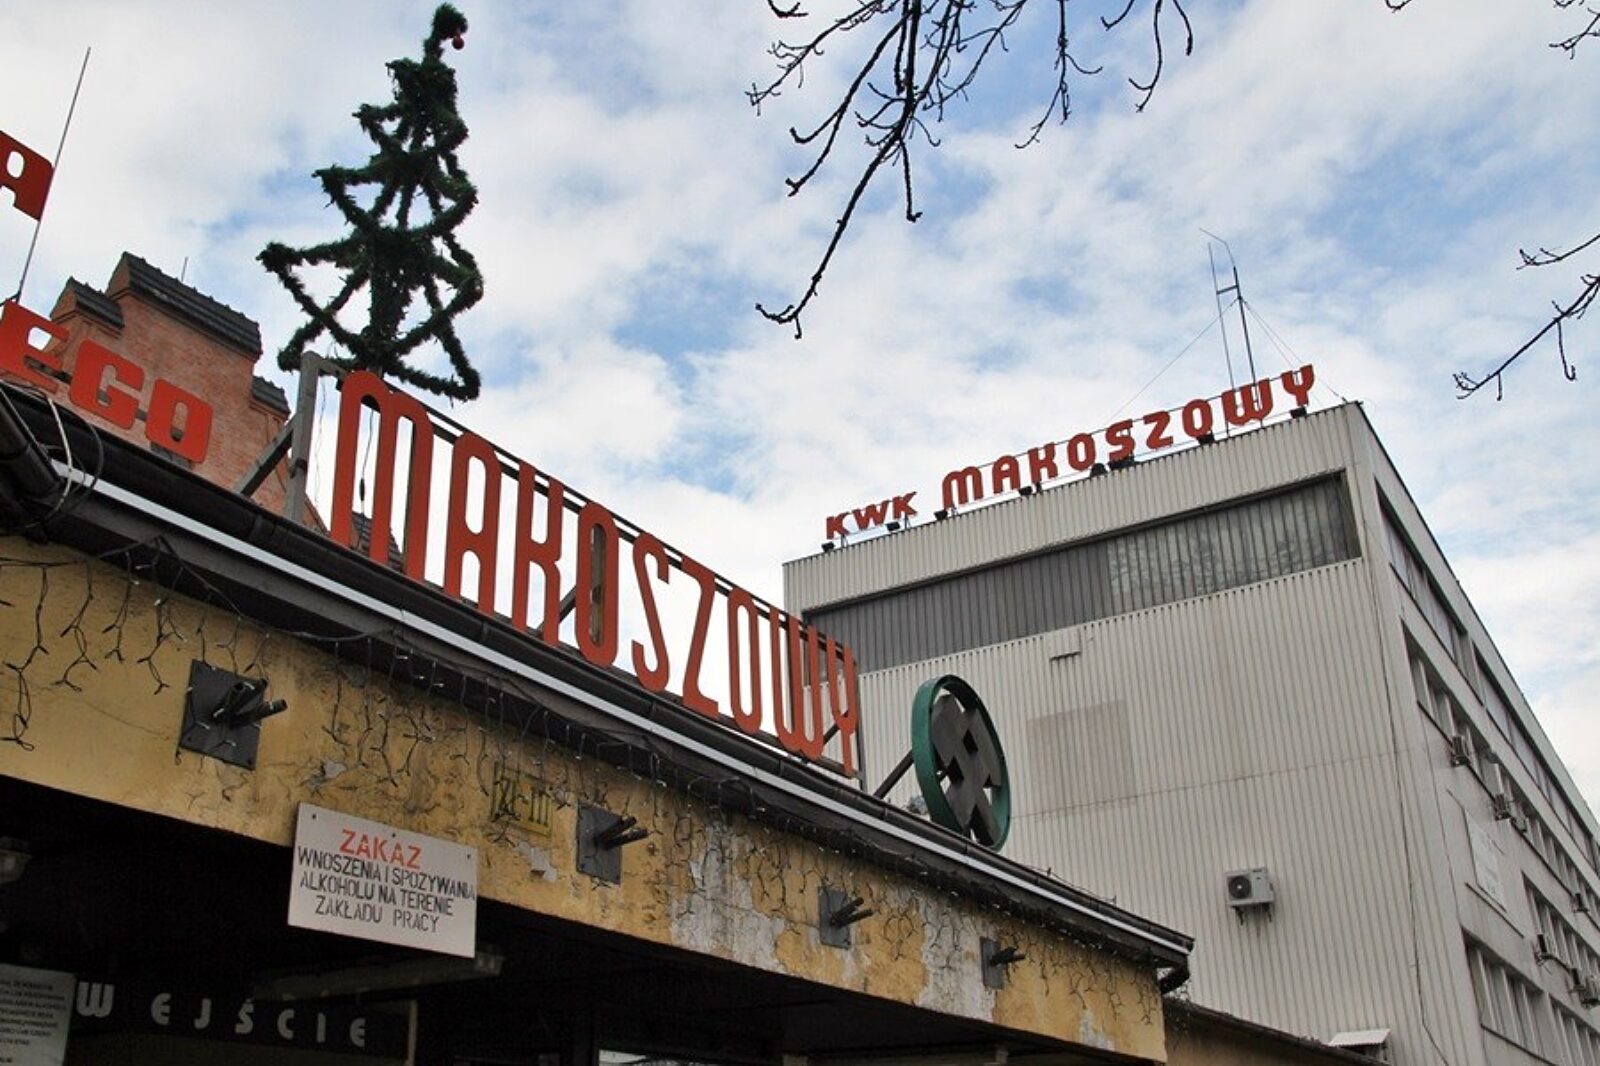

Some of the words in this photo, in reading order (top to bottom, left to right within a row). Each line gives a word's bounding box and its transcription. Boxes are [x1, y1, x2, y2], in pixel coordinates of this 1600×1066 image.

[826, 492, 918, 540] KWK
[942, 364, 1315, 508] MAKOSZOWY
[330, 369, 857, 778] MAKOSZOWY
[298, 847, 381, 882] WNOSZENIA
[385, 868, 389, 883] I
[340, 829, 421, 869] ZAKAZ
[300, 871, 374, 900] ALKOHOLU
[379, 886, 397, 905] NA
[399, 889, 454, 916] TERENIE
[315, 895, 382, 923] ZAKŁADU
[393, 909, 440, 933] PRACY
